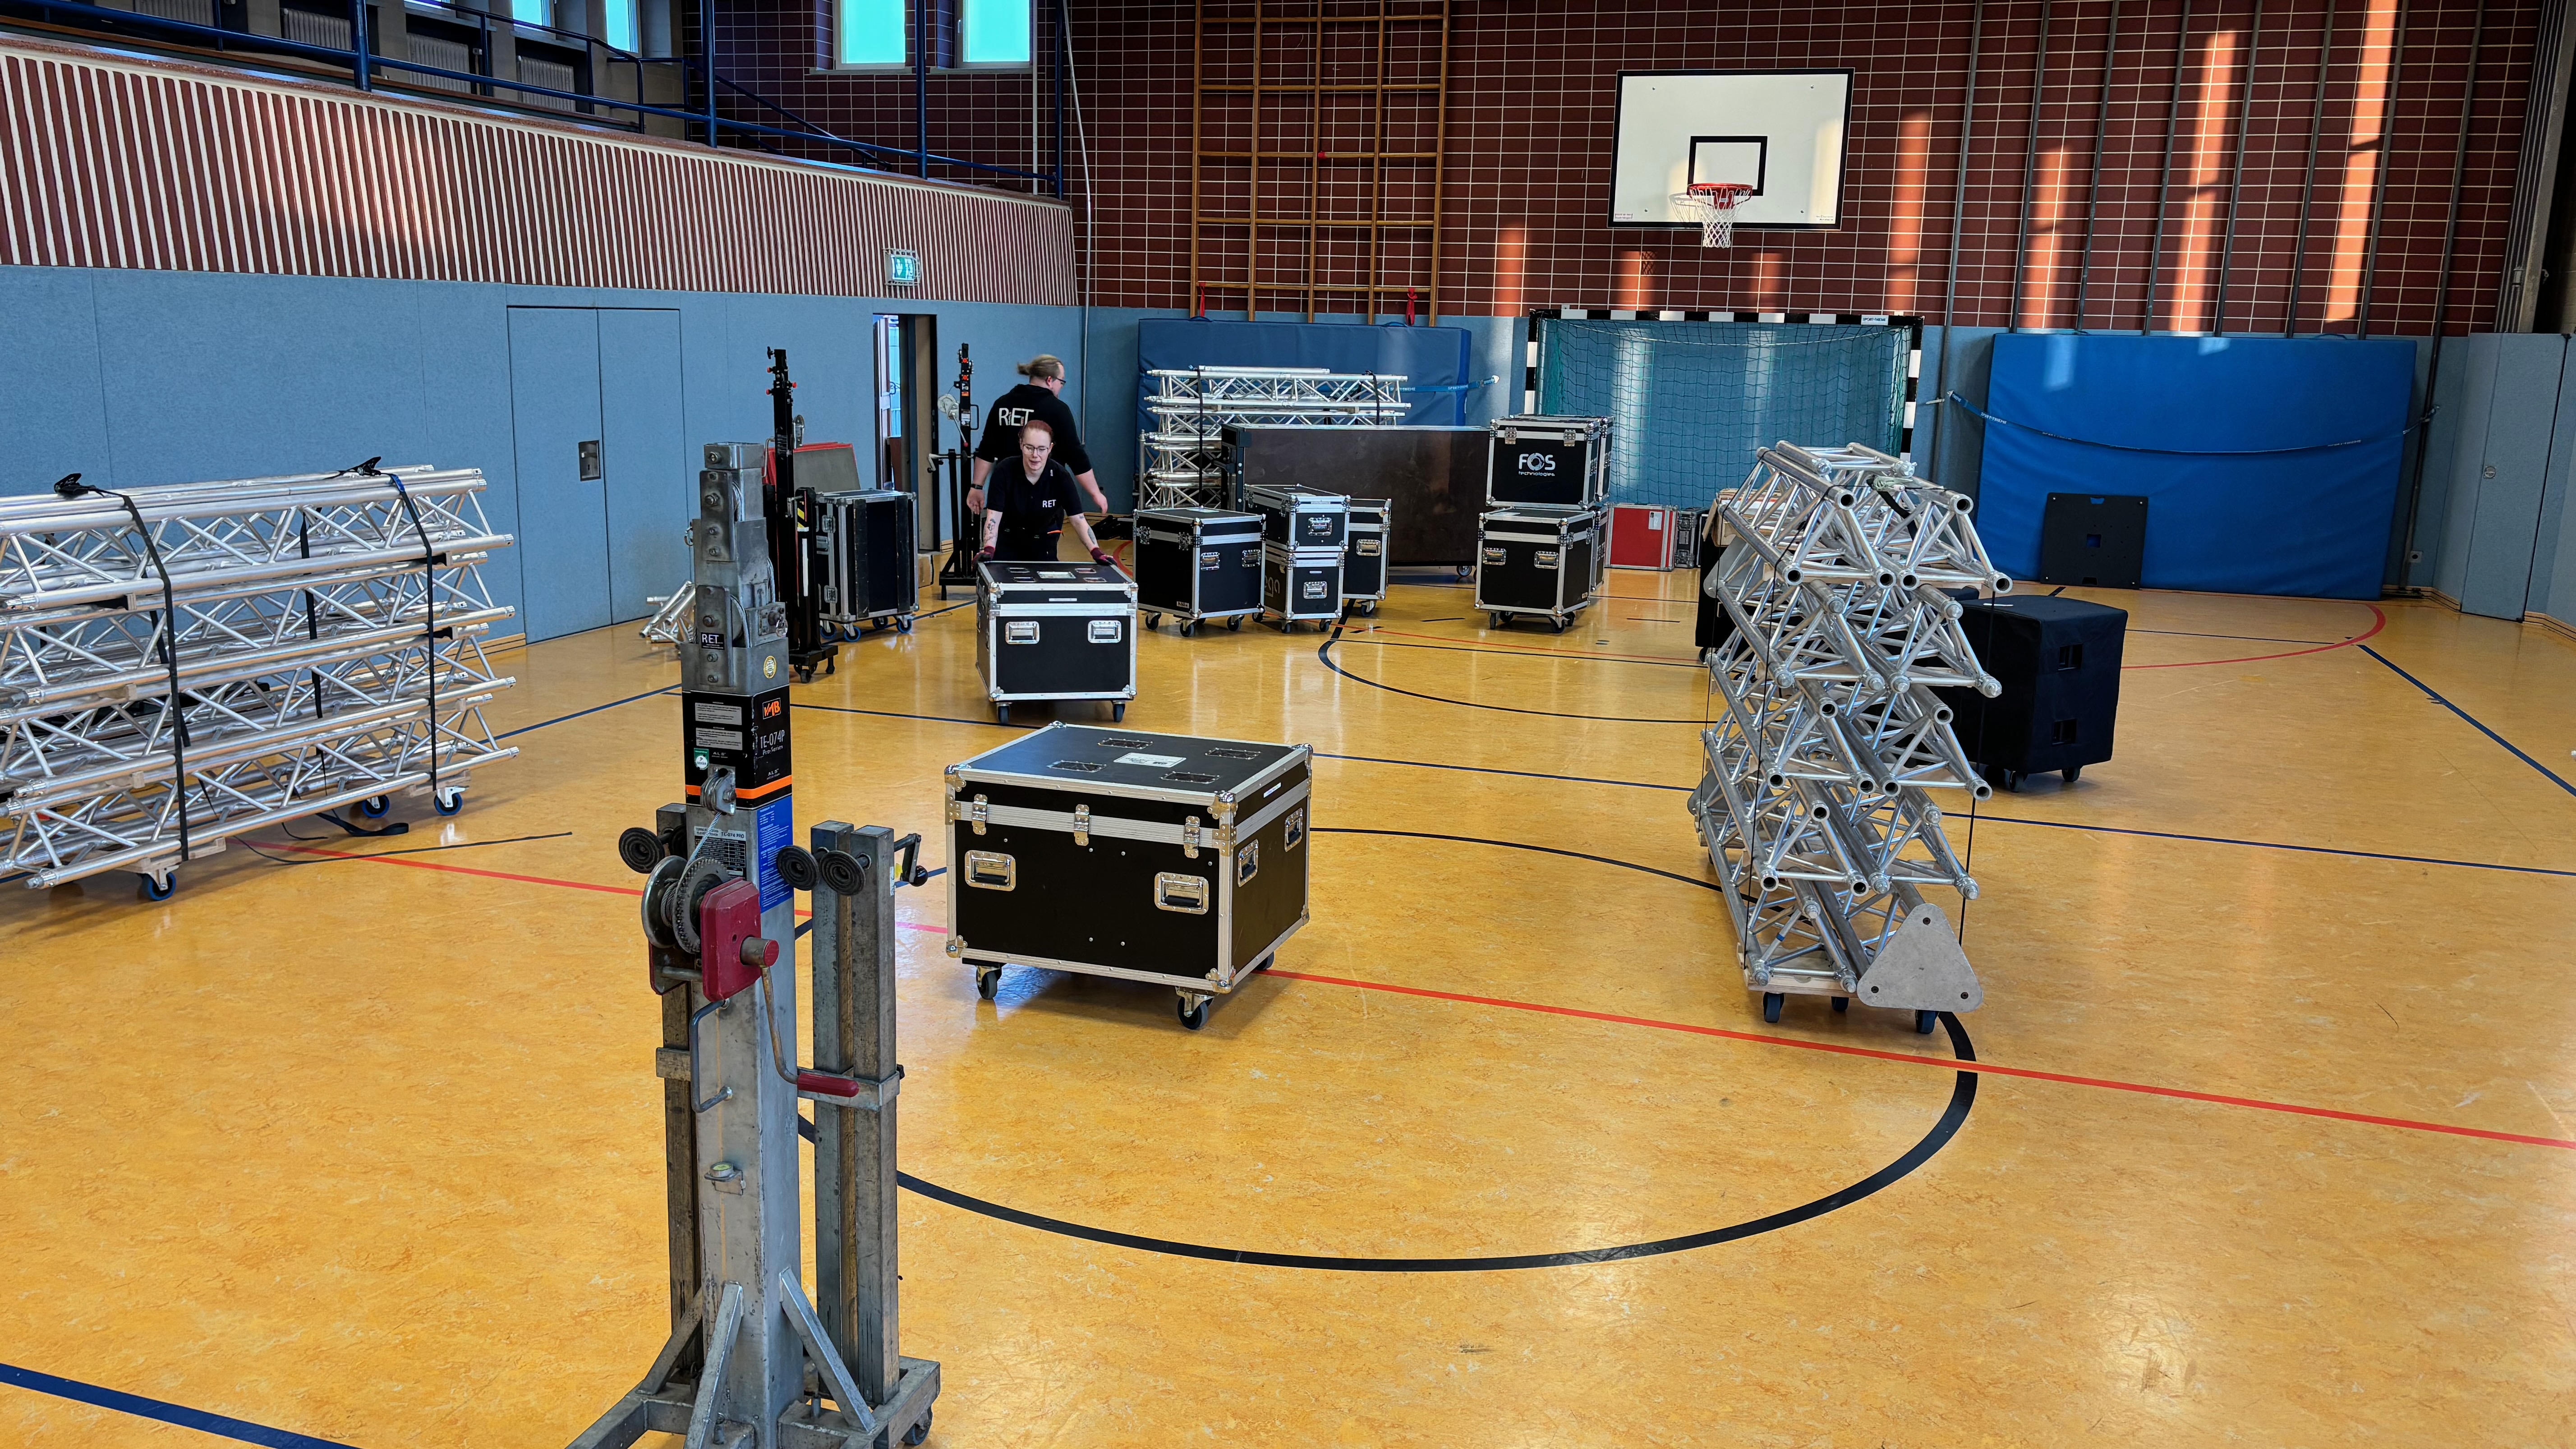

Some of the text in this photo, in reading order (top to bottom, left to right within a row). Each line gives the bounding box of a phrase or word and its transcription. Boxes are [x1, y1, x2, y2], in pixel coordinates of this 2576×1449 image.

[1518, 452, 1556, 471] FOS
[1042, 499, 1056, 508] RET
[702, 634, 719, 644] RET
[760, 729, 785, 749] TE-074P
